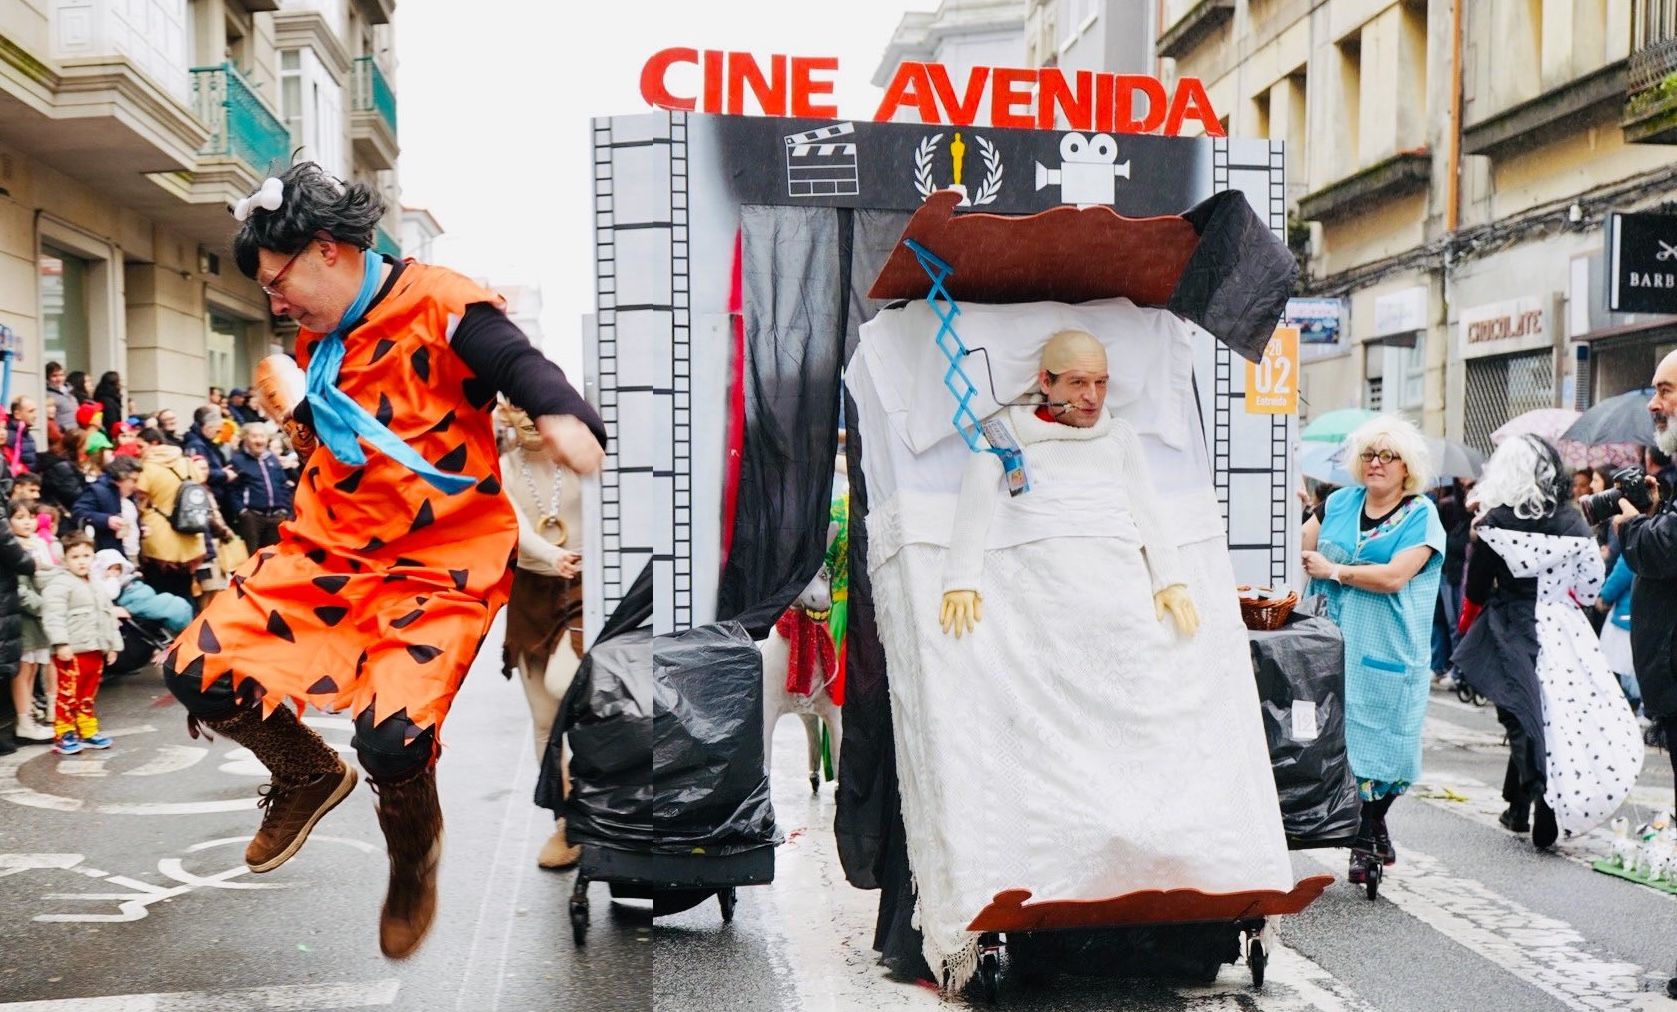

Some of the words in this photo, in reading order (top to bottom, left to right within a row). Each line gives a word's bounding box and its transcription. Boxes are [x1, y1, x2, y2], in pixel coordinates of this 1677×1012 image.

[640, 47, 839, 119] CINE
[873, 62, 1227, 137] AVENIDA
[1630, 271, 1675, 289] BARB
[1467, 308, 1543, 344] CHOCOLATE
[1255, 355, 1291, 393] 02
